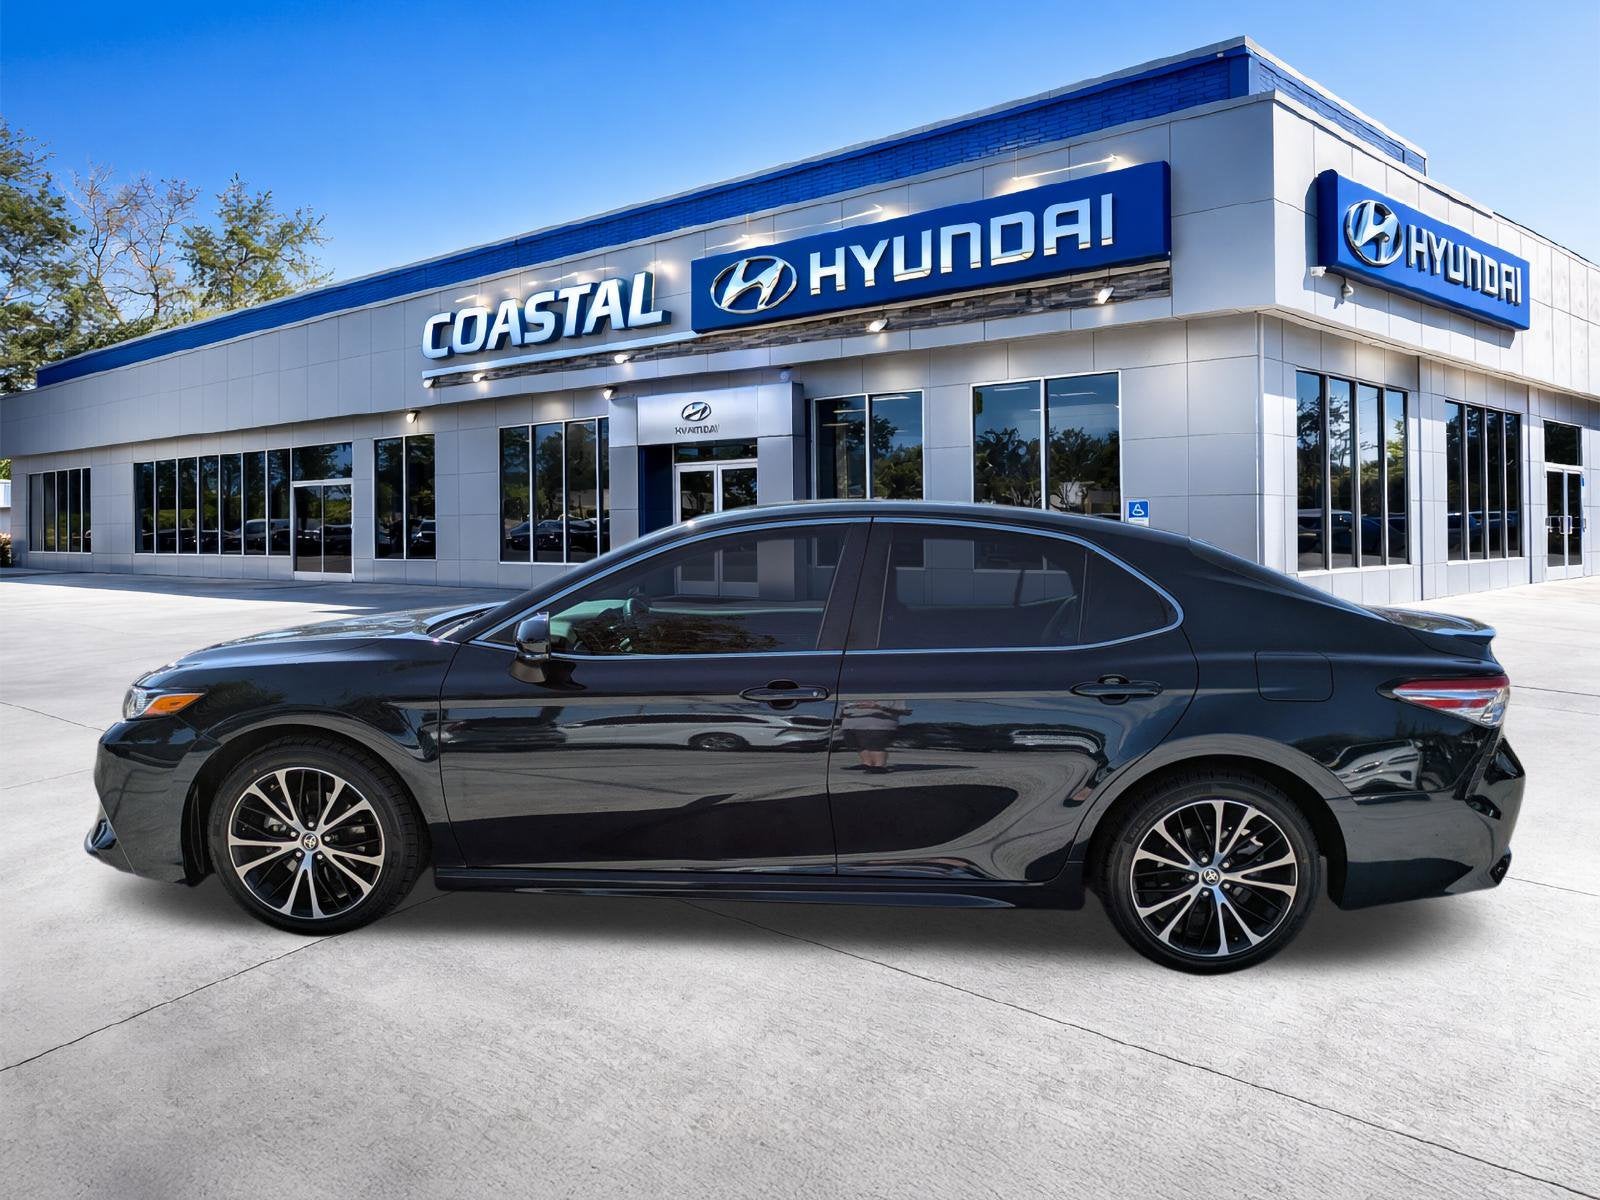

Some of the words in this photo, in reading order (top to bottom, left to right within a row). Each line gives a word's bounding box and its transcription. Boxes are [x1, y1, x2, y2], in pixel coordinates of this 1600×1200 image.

[809, 193, 1114, 296] HYUNDAI
[1406, 224, 1522, 306] HYUNDAI
[422, 271, 667, 360] COASTAL
